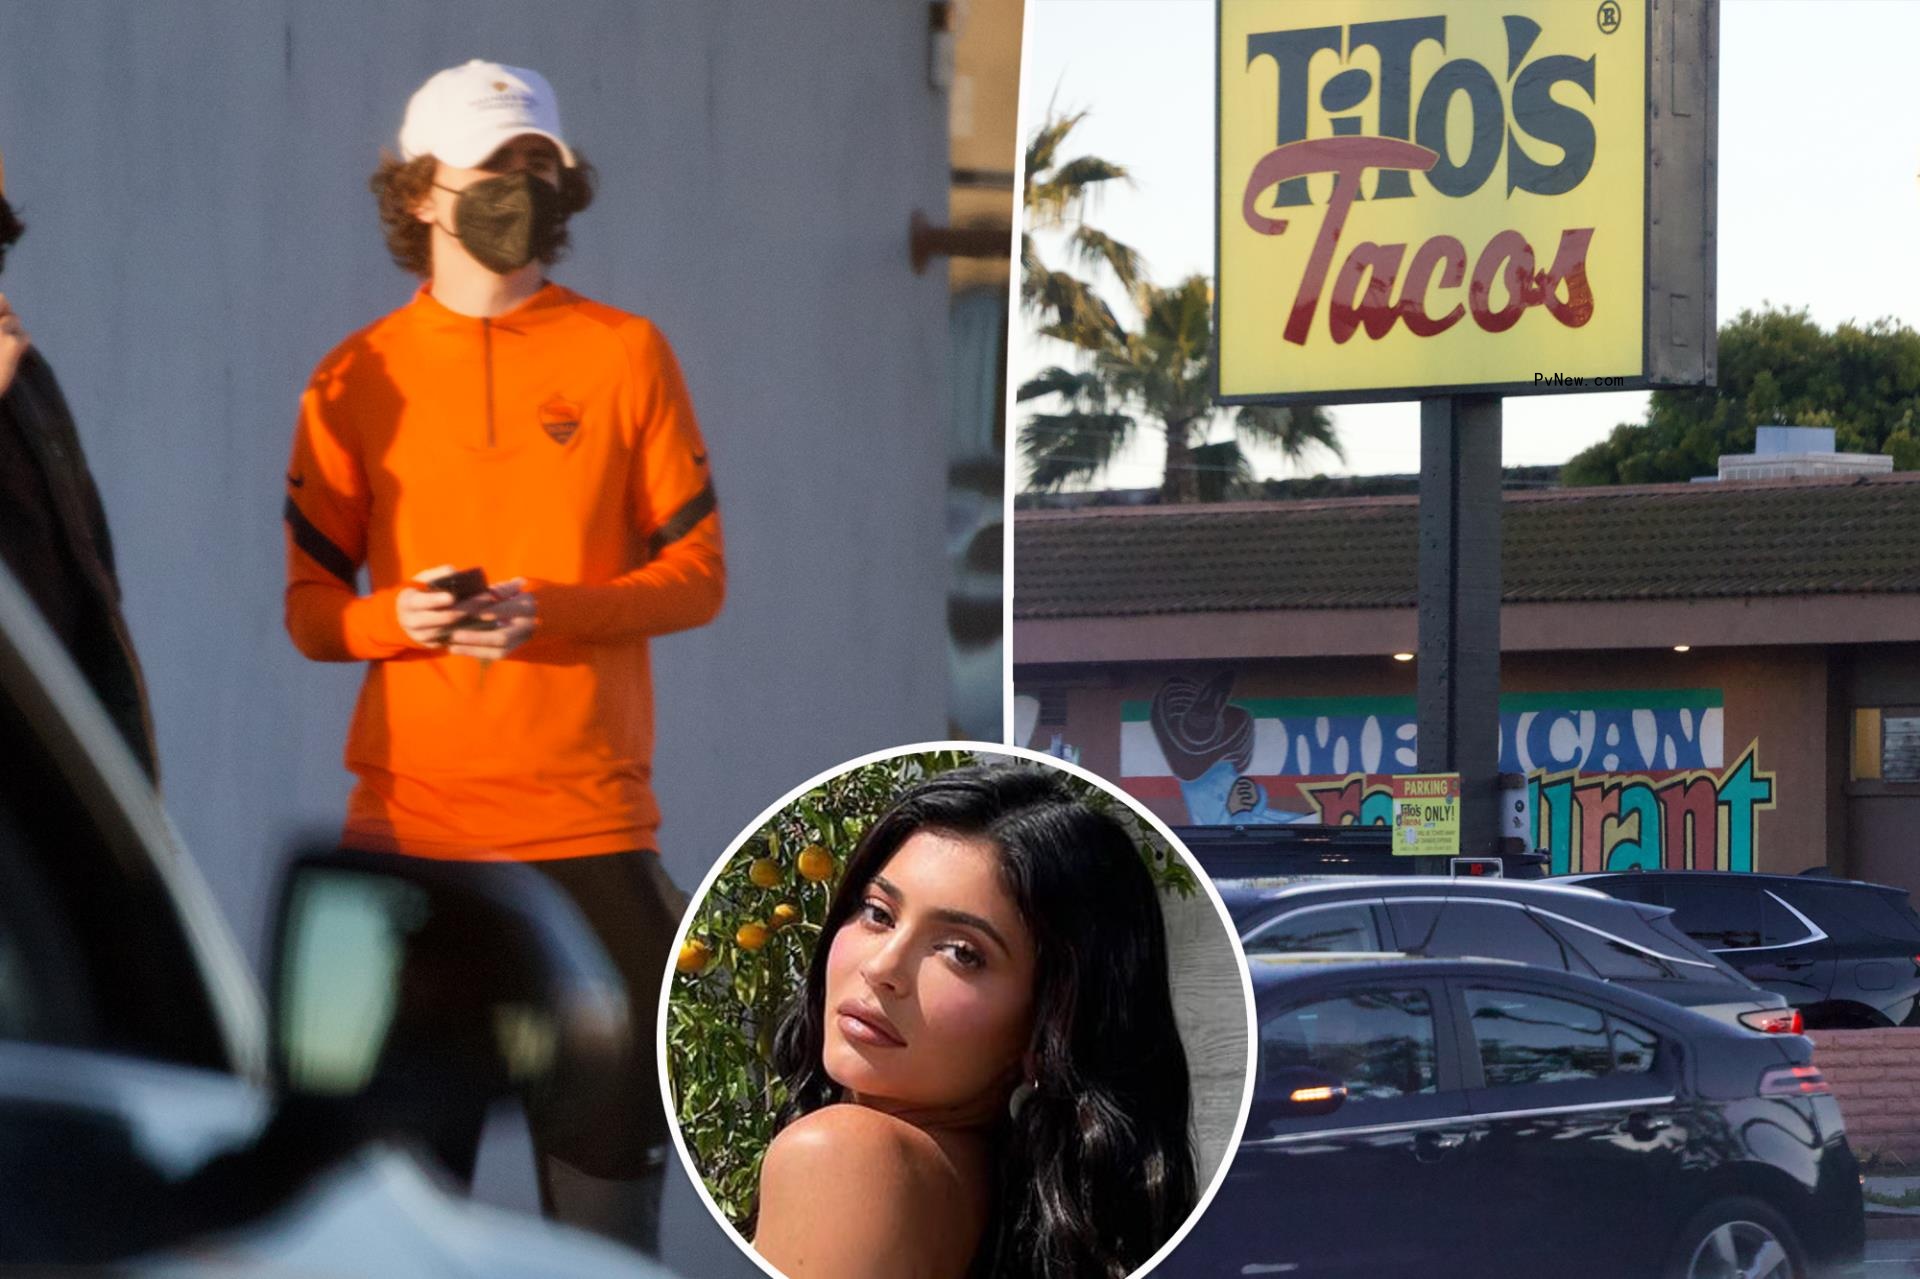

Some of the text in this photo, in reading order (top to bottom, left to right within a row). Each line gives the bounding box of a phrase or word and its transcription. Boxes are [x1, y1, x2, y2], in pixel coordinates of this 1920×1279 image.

[1242, 136, 1596, 346] Tacos
[1279, 707, 1709, 776] MEICAN
[1404, 779, 1448, 796] PARKING
[1424, 805, 1455, 822] ONLY!
